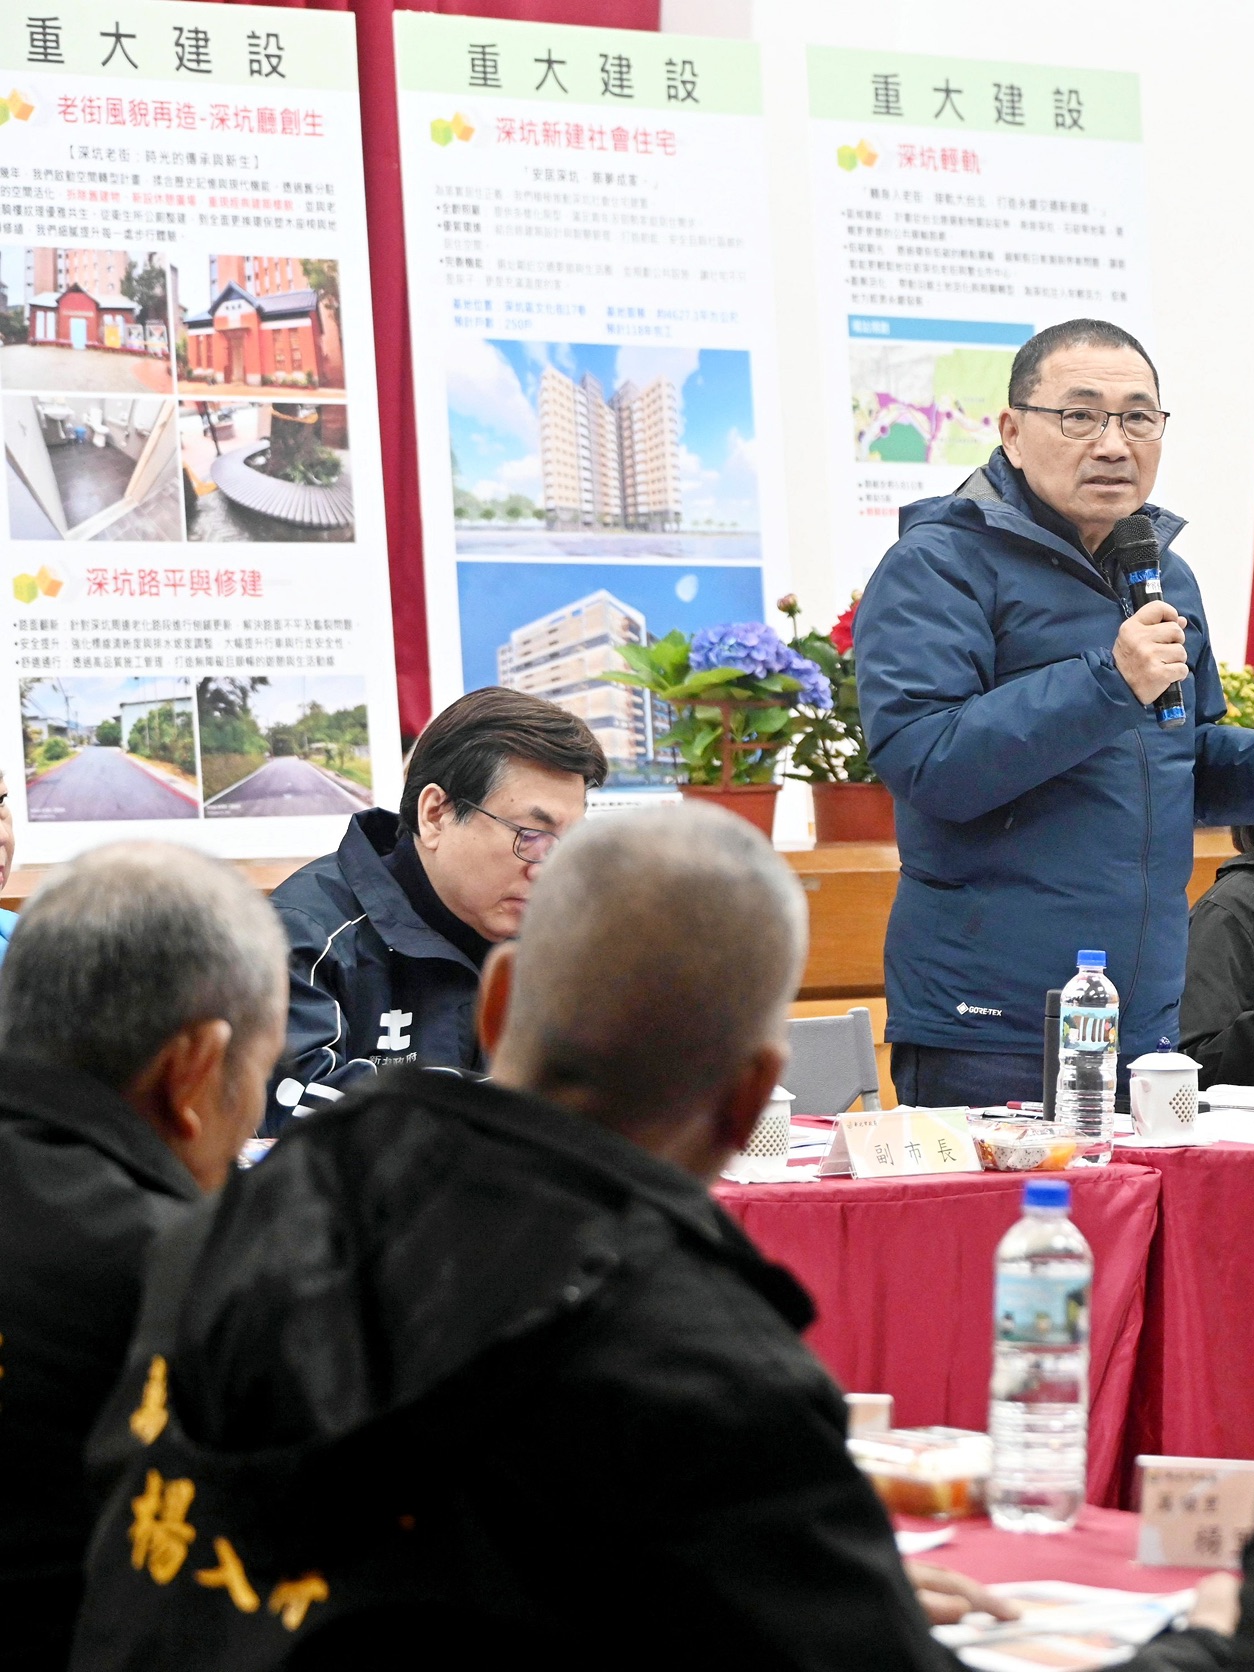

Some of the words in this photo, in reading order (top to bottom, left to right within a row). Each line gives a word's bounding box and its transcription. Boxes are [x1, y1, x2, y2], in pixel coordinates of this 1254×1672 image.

[25, 16, 287, 79] 重大建設
[467, 43, 700, 104] 重大建設
[57, 95, 326, 138] 老街風貌再造-深坑廳創生
[872, 73, 1085, 131] 重大建設
[495, 116, 677, 156] 深坑新建社會住宅
[897, 143, 981, 175] 深坑輕軌
[86, 568, 265, 598] 深坑路平與修建
[969, 1006, 1002, 1016] GORE-TEX
[874, 1138, 957, 1166] 副市長
